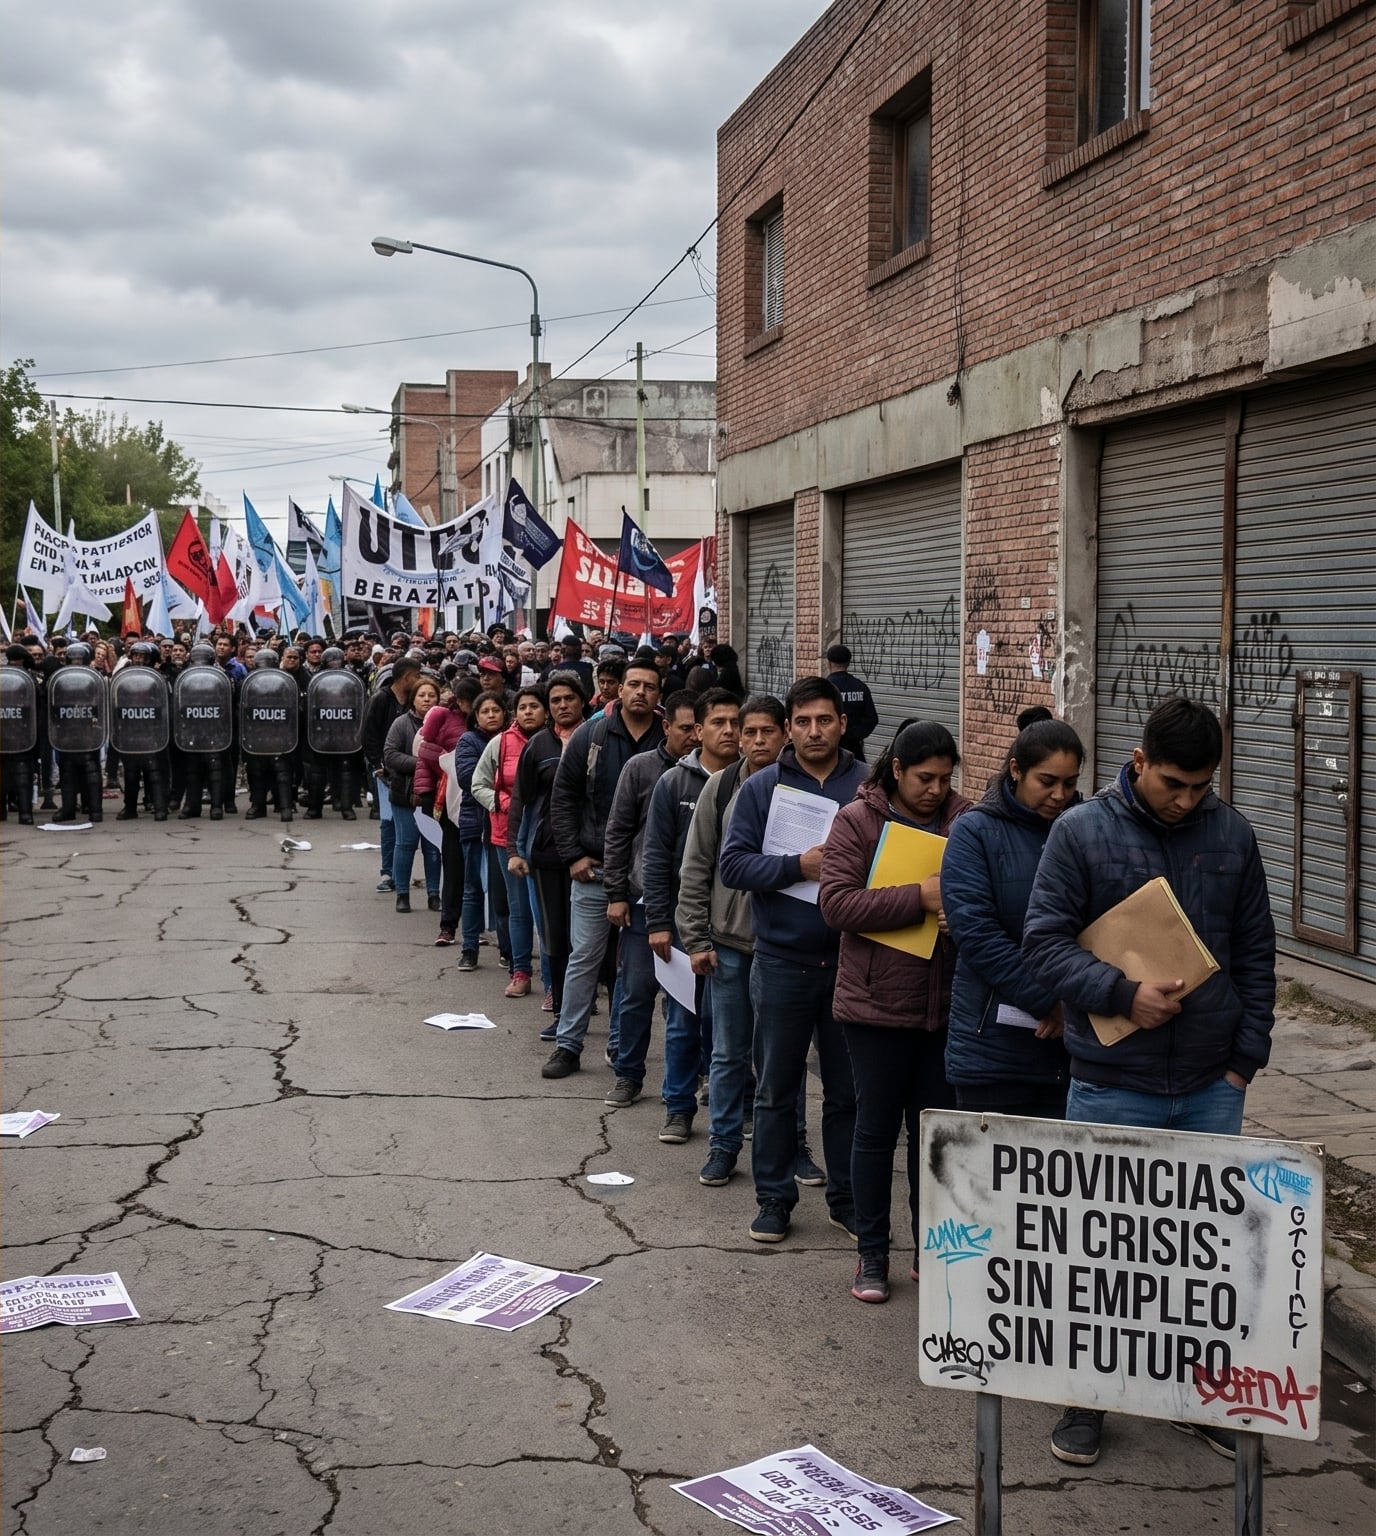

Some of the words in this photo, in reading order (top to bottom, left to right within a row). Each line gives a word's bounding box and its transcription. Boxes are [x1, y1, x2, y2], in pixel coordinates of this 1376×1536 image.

[121, 707, 156, 719] POLICE
[252, 708, 286, 721] POLICE
[319, 708, 353, 720] POLICE
[992, 1142, 1247, 1217] PROVINCIAS
[1015, 1202, 1068, 1255] EN
[1081, 1209, 1232, 1273] CRISIS:
[986, 1256, 1053, 1310] SIN
[1067, 1263, 1251, 1341] EMPLEO,
[987, 1312, 1054, 1367] SIN
[1068, 1320, 1232, 1389] FUTURO
